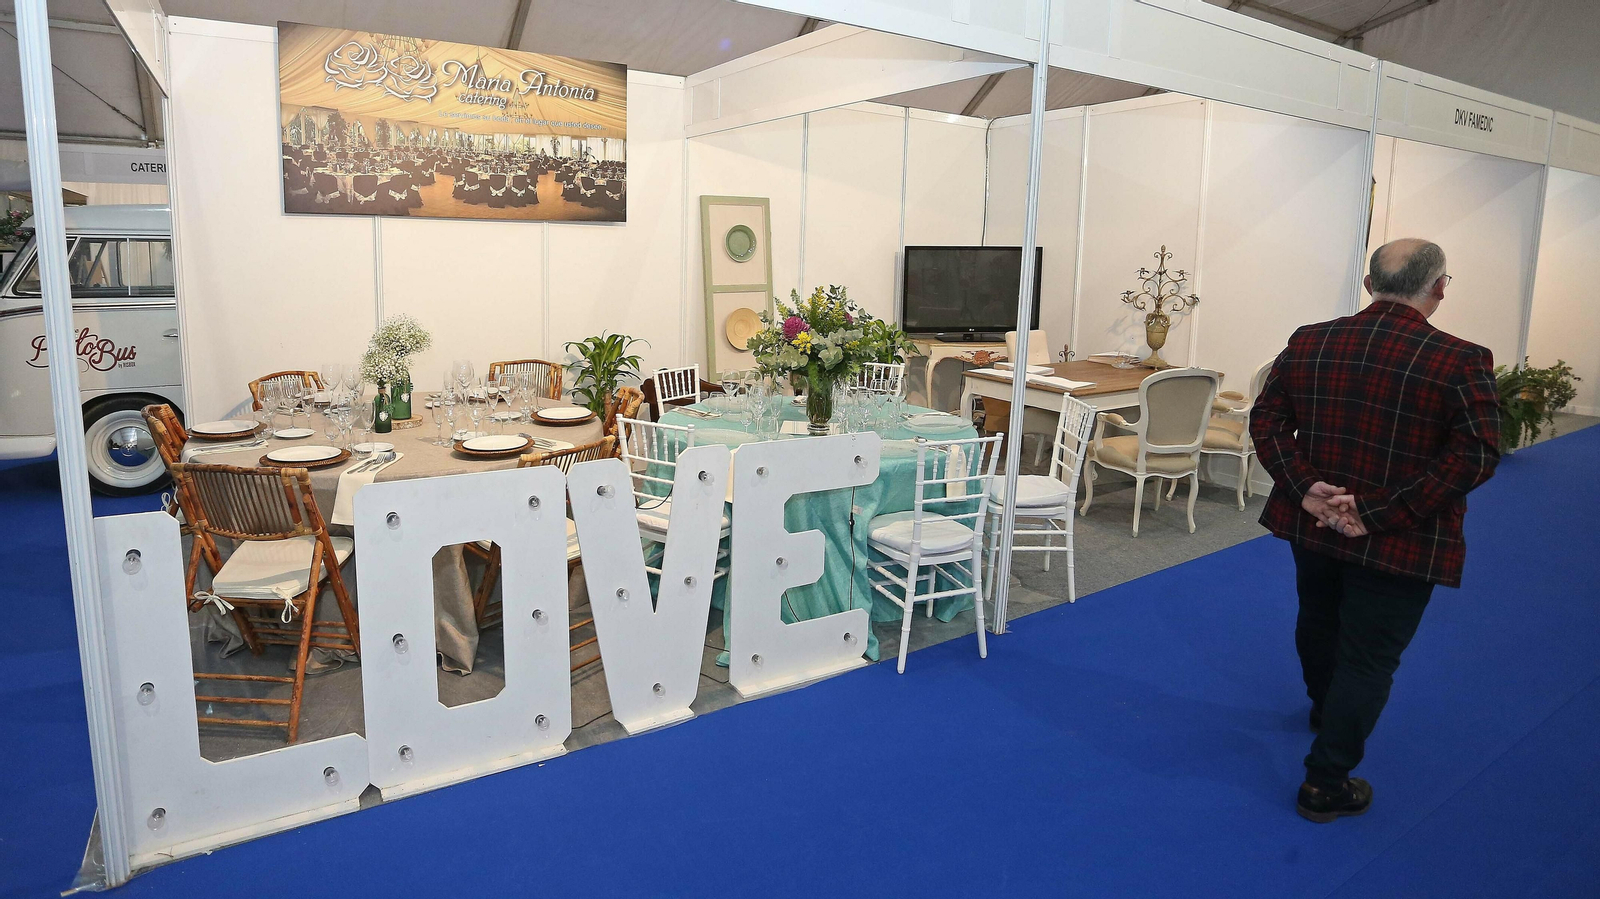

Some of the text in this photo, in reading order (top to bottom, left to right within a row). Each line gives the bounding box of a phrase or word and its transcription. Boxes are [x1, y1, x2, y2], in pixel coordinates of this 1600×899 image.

[441, 60, 596, 101] Maria Antonia
[458, 92, 508, 110] catering
[532, 118, 549, 127] lugar
[550, 120, 563, 128] que
[564, 120, 581, 129] usted
[1454, 108, 1494, 133] DKV FAMEDIC
[130, 162, 167, 173] CATERI
[94, 431, 880, 868] LOVE
